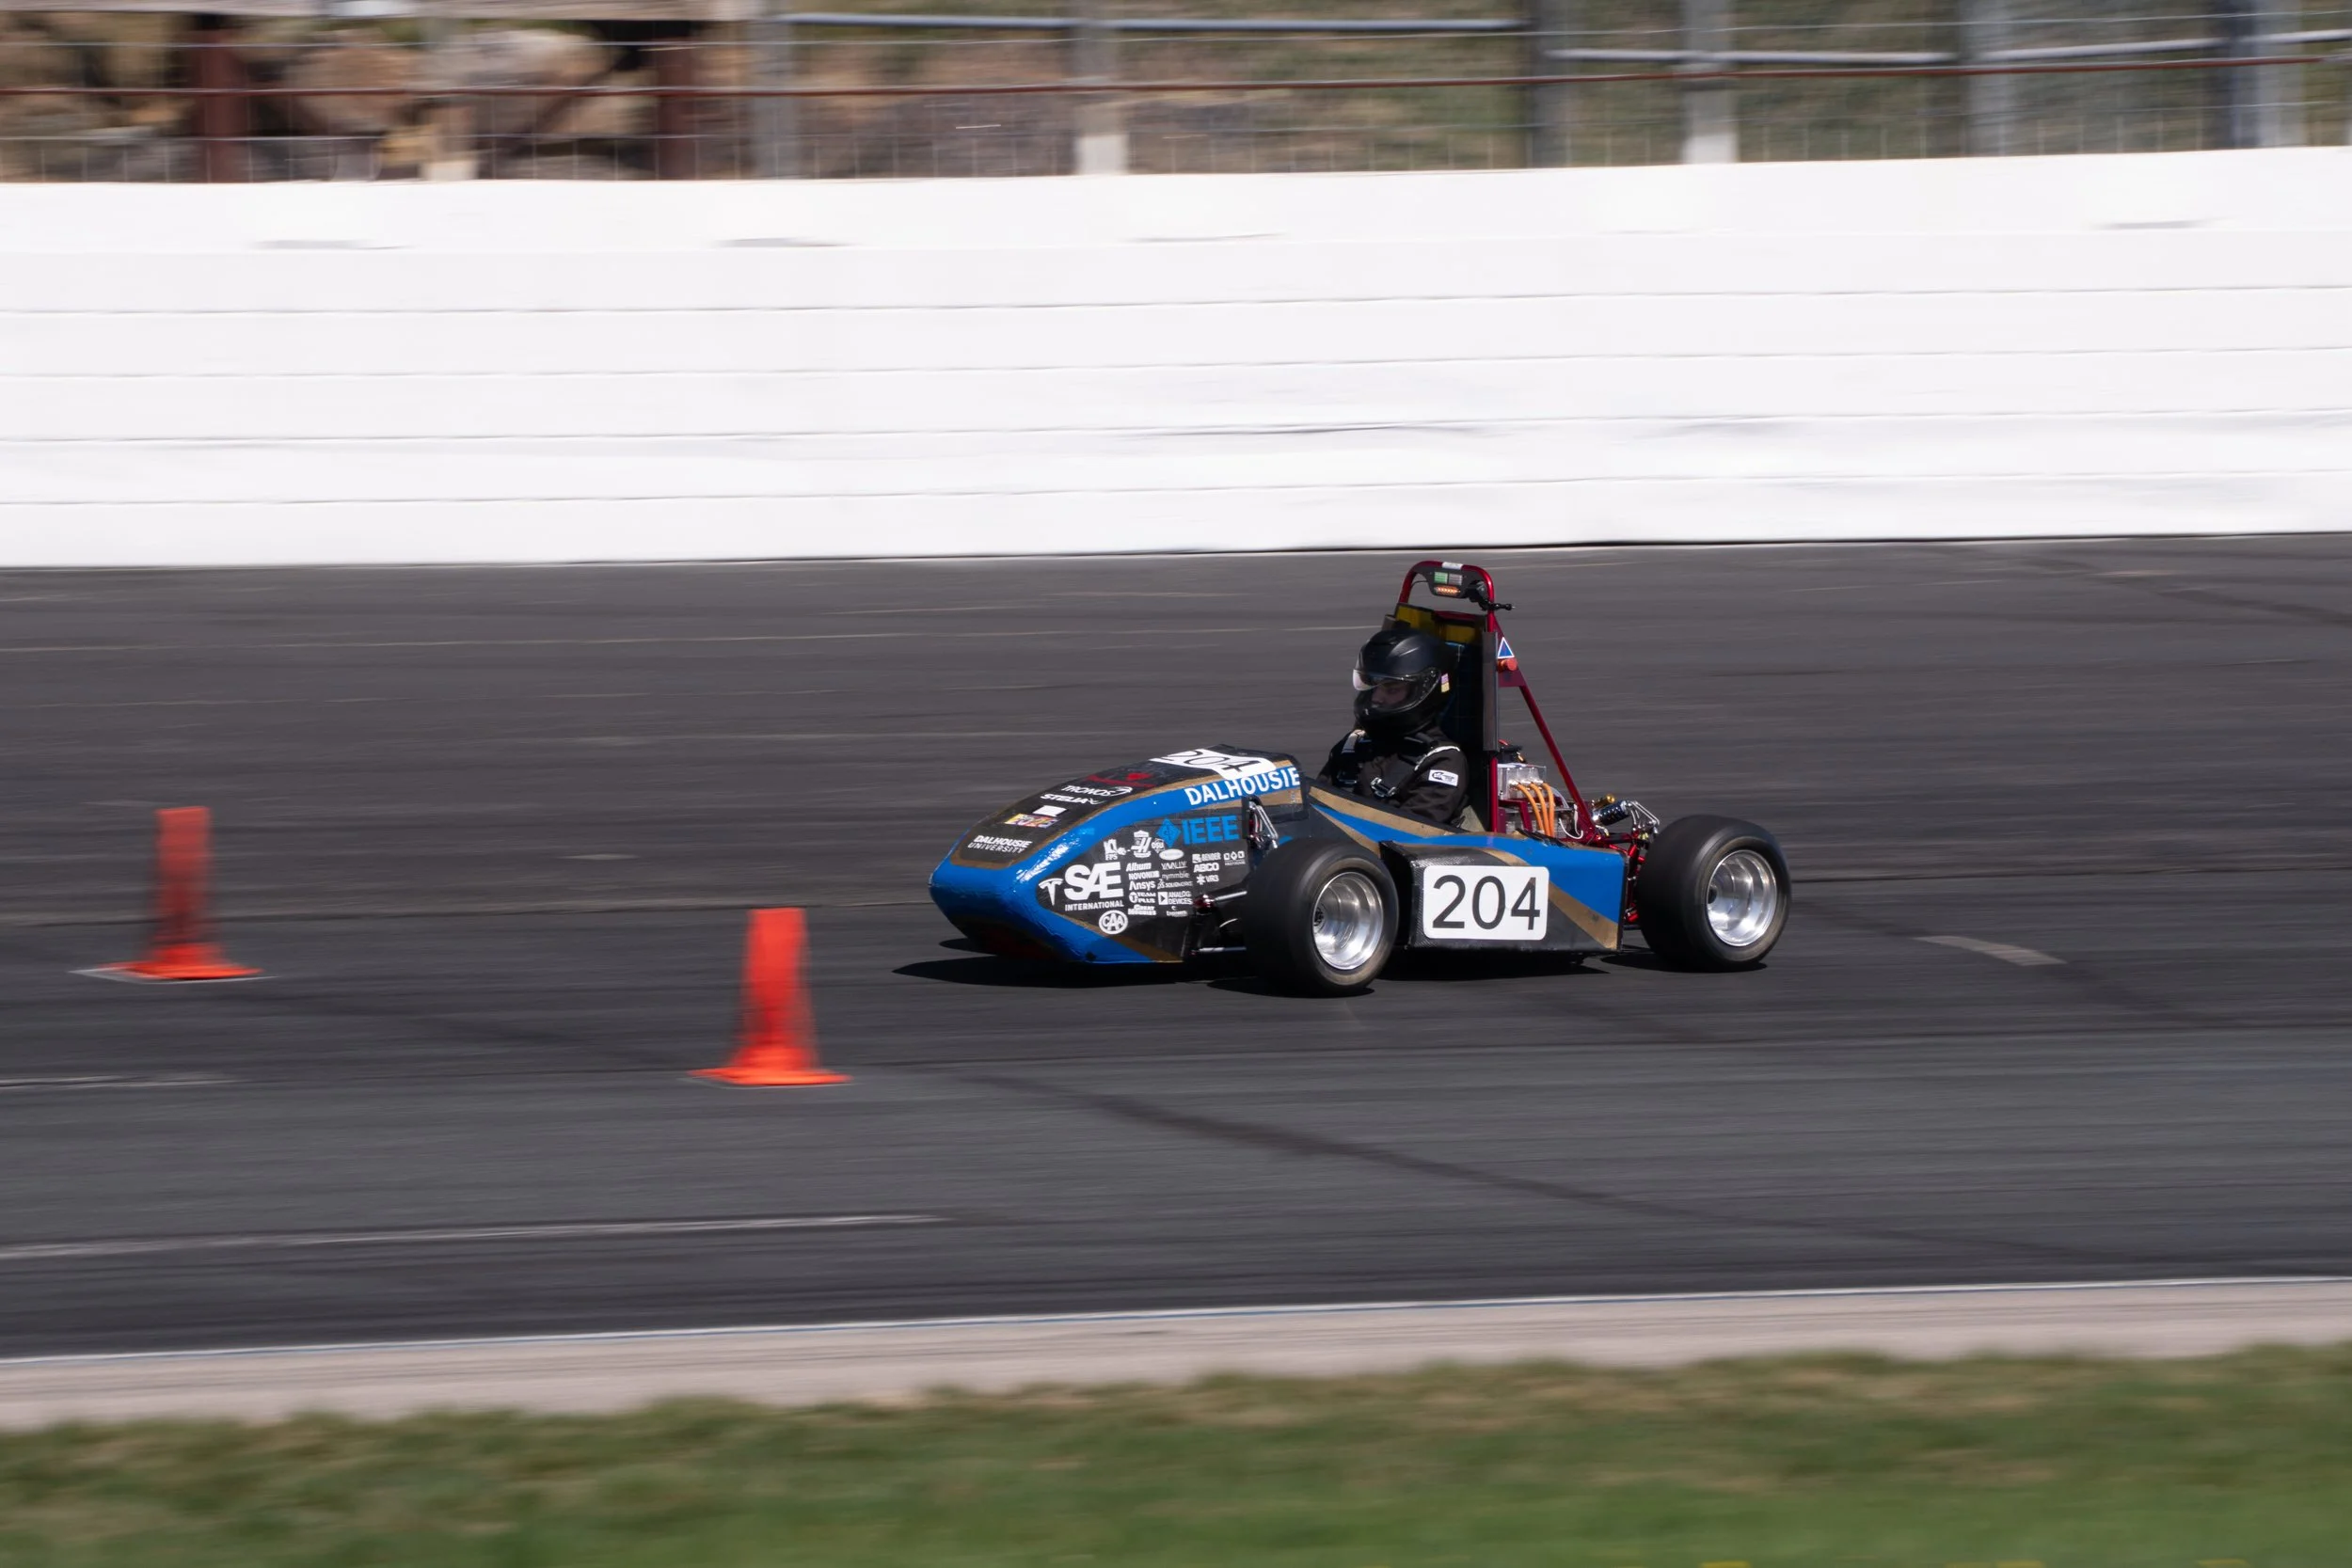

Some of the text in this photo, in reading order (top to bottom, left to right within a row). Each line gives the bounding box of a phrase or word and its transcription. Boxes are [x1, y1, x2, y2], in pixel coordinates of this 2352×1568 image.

[1160, 750, 1261, 773] 204
[1184, 767, 1301, 806] DALHOUSIE
[1182, 816, 1241, 845] IEEE
[967, 842, 1025, 854] UNIVERSITY
[973, 834, 1033, 848] DALHOUSIE
[1193, 863, 1220, 873] ABCO
[1129, 880, 1156, 891] Ansys
[1064, 900, 1125, 911] INTERNATIONAL
[1432, 874, 1541, 931] 204
[1102, 913, 1125, 931] CAA
